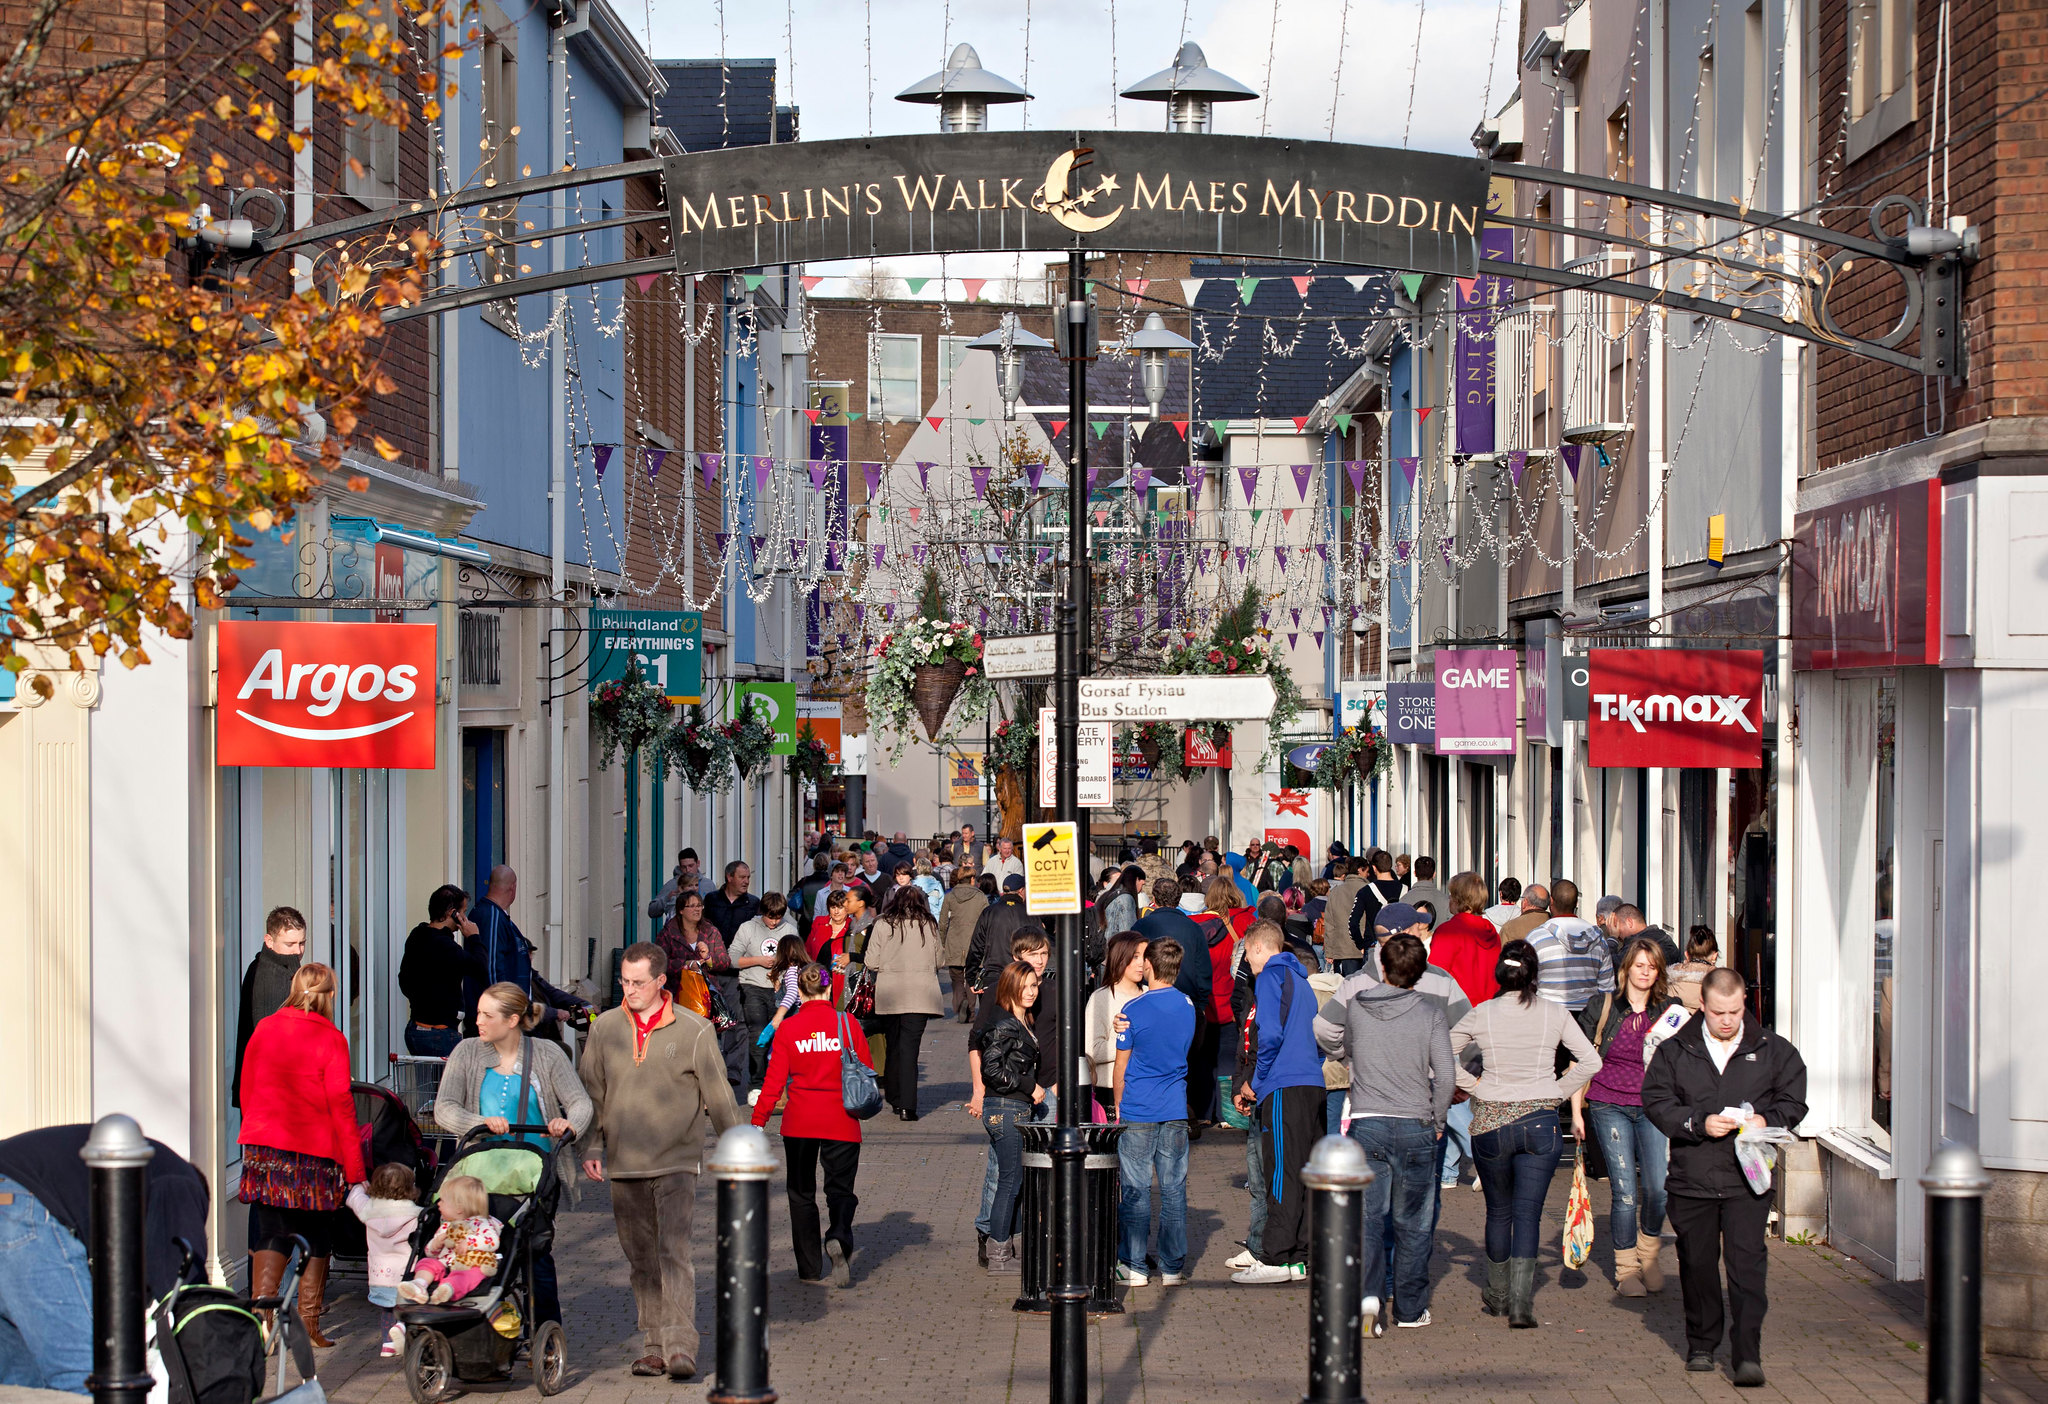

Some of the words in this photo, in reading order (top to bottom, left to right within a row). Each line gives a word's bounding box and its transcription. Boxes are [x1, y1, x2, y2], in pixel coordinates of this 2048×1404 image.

[680, 183, 882, 235] MERLIN'S
[893, 174, 1028, 211] WALK
[1130, 172, 1248, 214] MAES
[1259, 179, 1479, 236] MYRDDIN
[602, 617, 678, 631] Poundland
[605, 637, 694, 650] EVERYTHING'S
[237, 649, 418, 717] Argos
[1441, 668, 1510, 688] GAME
[1081, 683, 1132, 697] Gorsaf
[1138, 683, 1185, 701] Fysiau
[1399, 697, 1436, 707] STORE
[1081, 703, 1108, 716] Bus
[1399, 707, 1436, 715] TWENTY
[1399, 715, 1436, 730] ONE
[1047, 737, 1106, 746] PERTY
[1454, 740, 1498, 748] game.co.uk
[1034, 860, 1068, 872] CCTV
[795, 1032, 842, 1054] wilko
